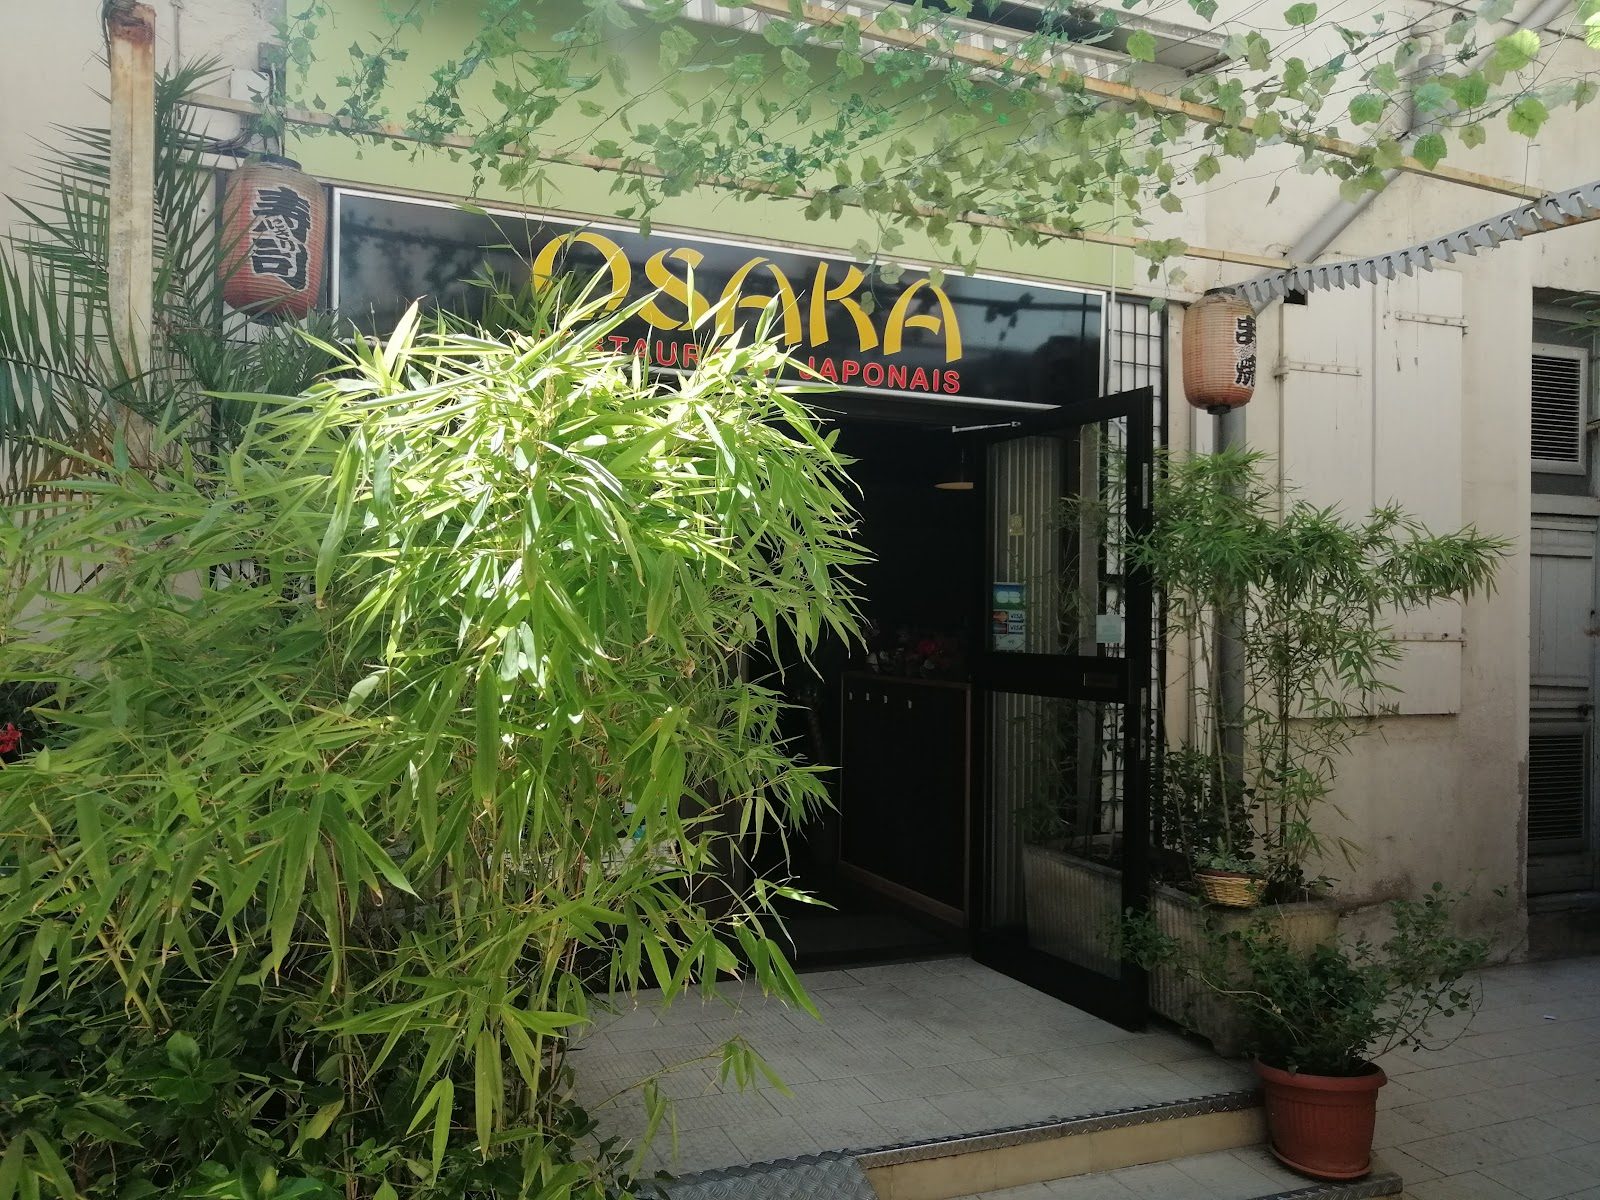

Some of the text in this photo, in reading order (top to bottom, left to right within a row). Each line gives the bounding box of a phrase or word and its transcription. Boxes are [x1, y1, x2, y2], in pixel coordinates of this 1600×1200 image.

[251, 186, 311, 290] 寿司
[532, 231, 963, 363] OSAKA
[798, 355, 961, 394] JAPONAIS
